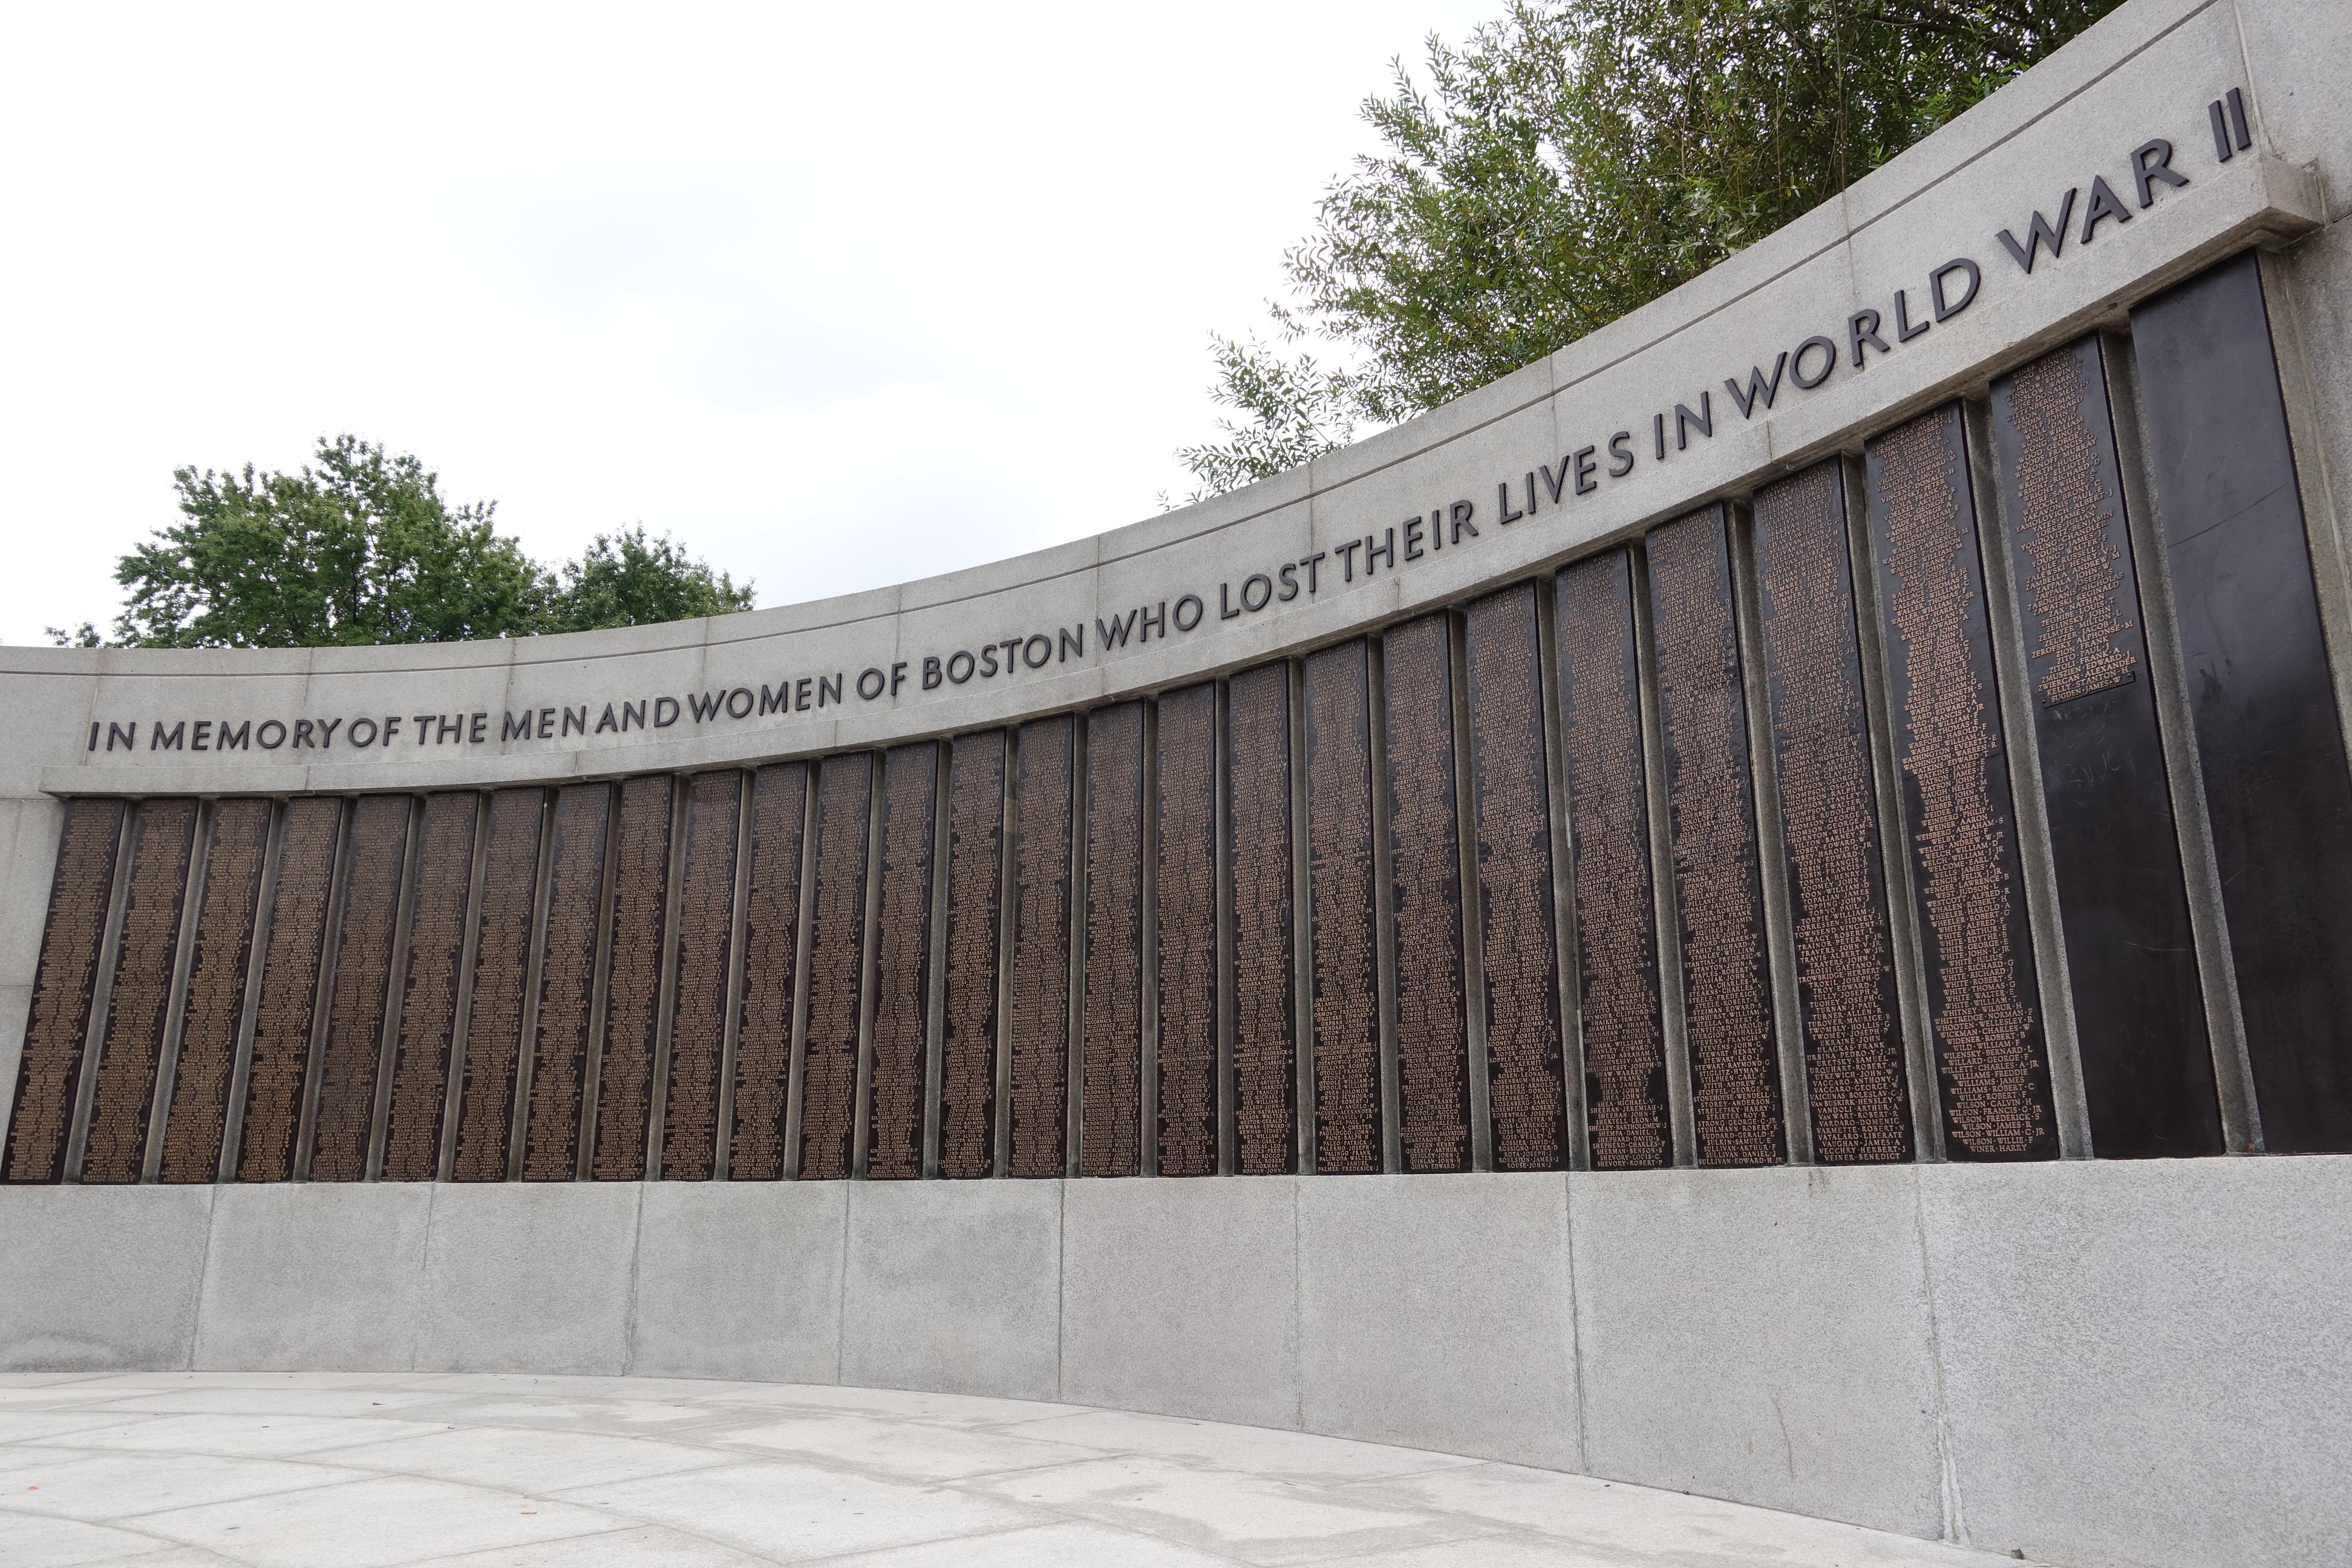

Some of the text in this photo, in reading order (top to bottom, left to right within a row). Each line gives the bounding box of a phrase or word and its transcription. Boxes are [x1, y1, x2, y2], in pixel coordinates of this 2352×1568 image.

[88, 87, 2252, 752] IN MEMORY OF THE MEN AND WOMEN OF BOSTON WHO LOST THEIR LIVES IN WORLD WAR II
[2023, 420, 2043, 435] WOLF
[2048, 408, 2068, 424] JOHN
[2025, 413, 2076, 440] WOLL DAVID
[2056, 636, 2108, 658] ZION FRANK
[2056, 653, 2075, 664] ZITO
[2081, 645, 2101, 657] PAUL
[2047, 683, 2071, 696] KELLY
[2076, 670, 2116, 688] STANTON
[2051, 687, 2081, 702] SUGDEN
[2085, 679, 2109, 692] JAMES
[1939, 937, 1963, 947] WHITE
[1967, 932, 1997, 943] EDYTHE
[1820, 1037, 1855, 1046] UKRAINE
[1976, 1040, 2011, 1049] WILLIAM
